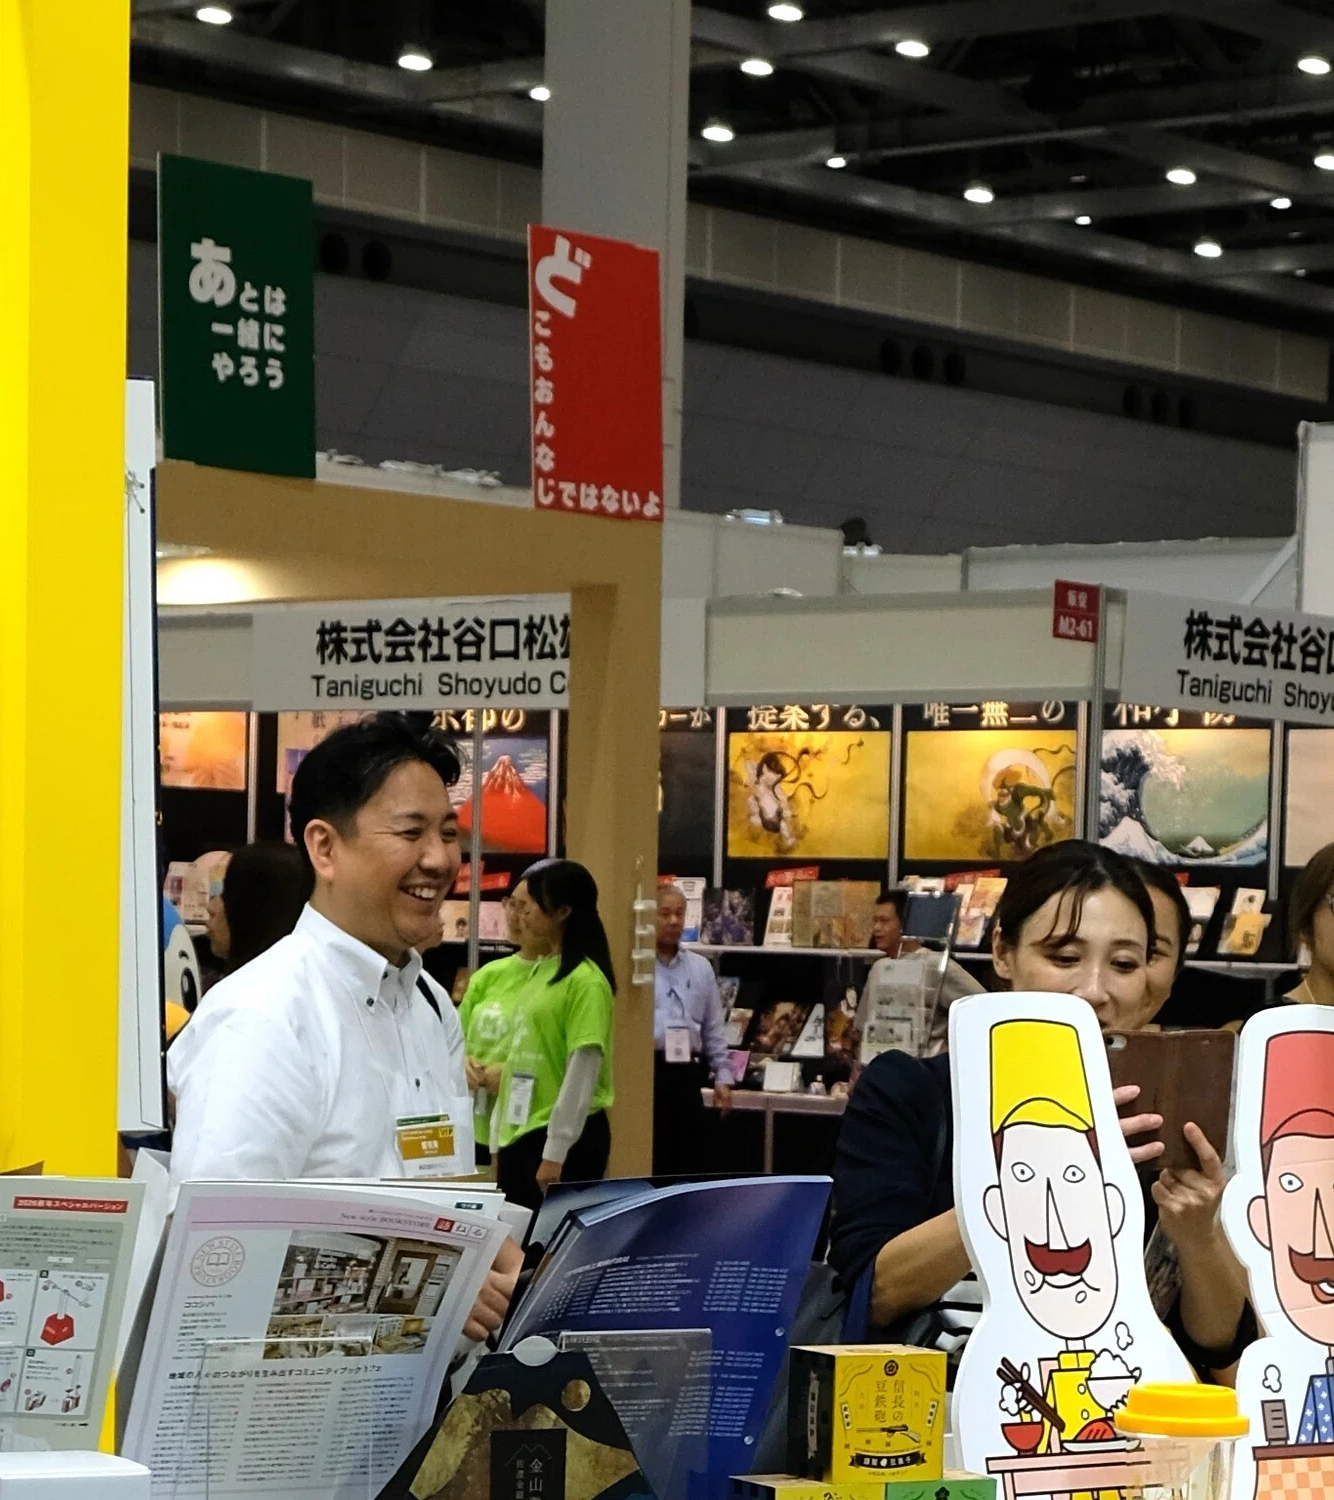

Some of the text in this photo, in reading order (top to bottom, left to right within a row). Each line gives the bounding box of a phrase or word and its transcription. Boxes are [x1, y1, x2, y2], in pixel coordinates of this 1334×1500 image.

[188, 238, 287, 319] あとは
[211, 351, 286, 391] やろう
[1058, 614, 1094, 639] M2-61
[311, 672, 423, 700] Taniguchi
[437, 671, 542, 699] Shoyudo
[1176, 669, 1274, 708] Taniguchi
